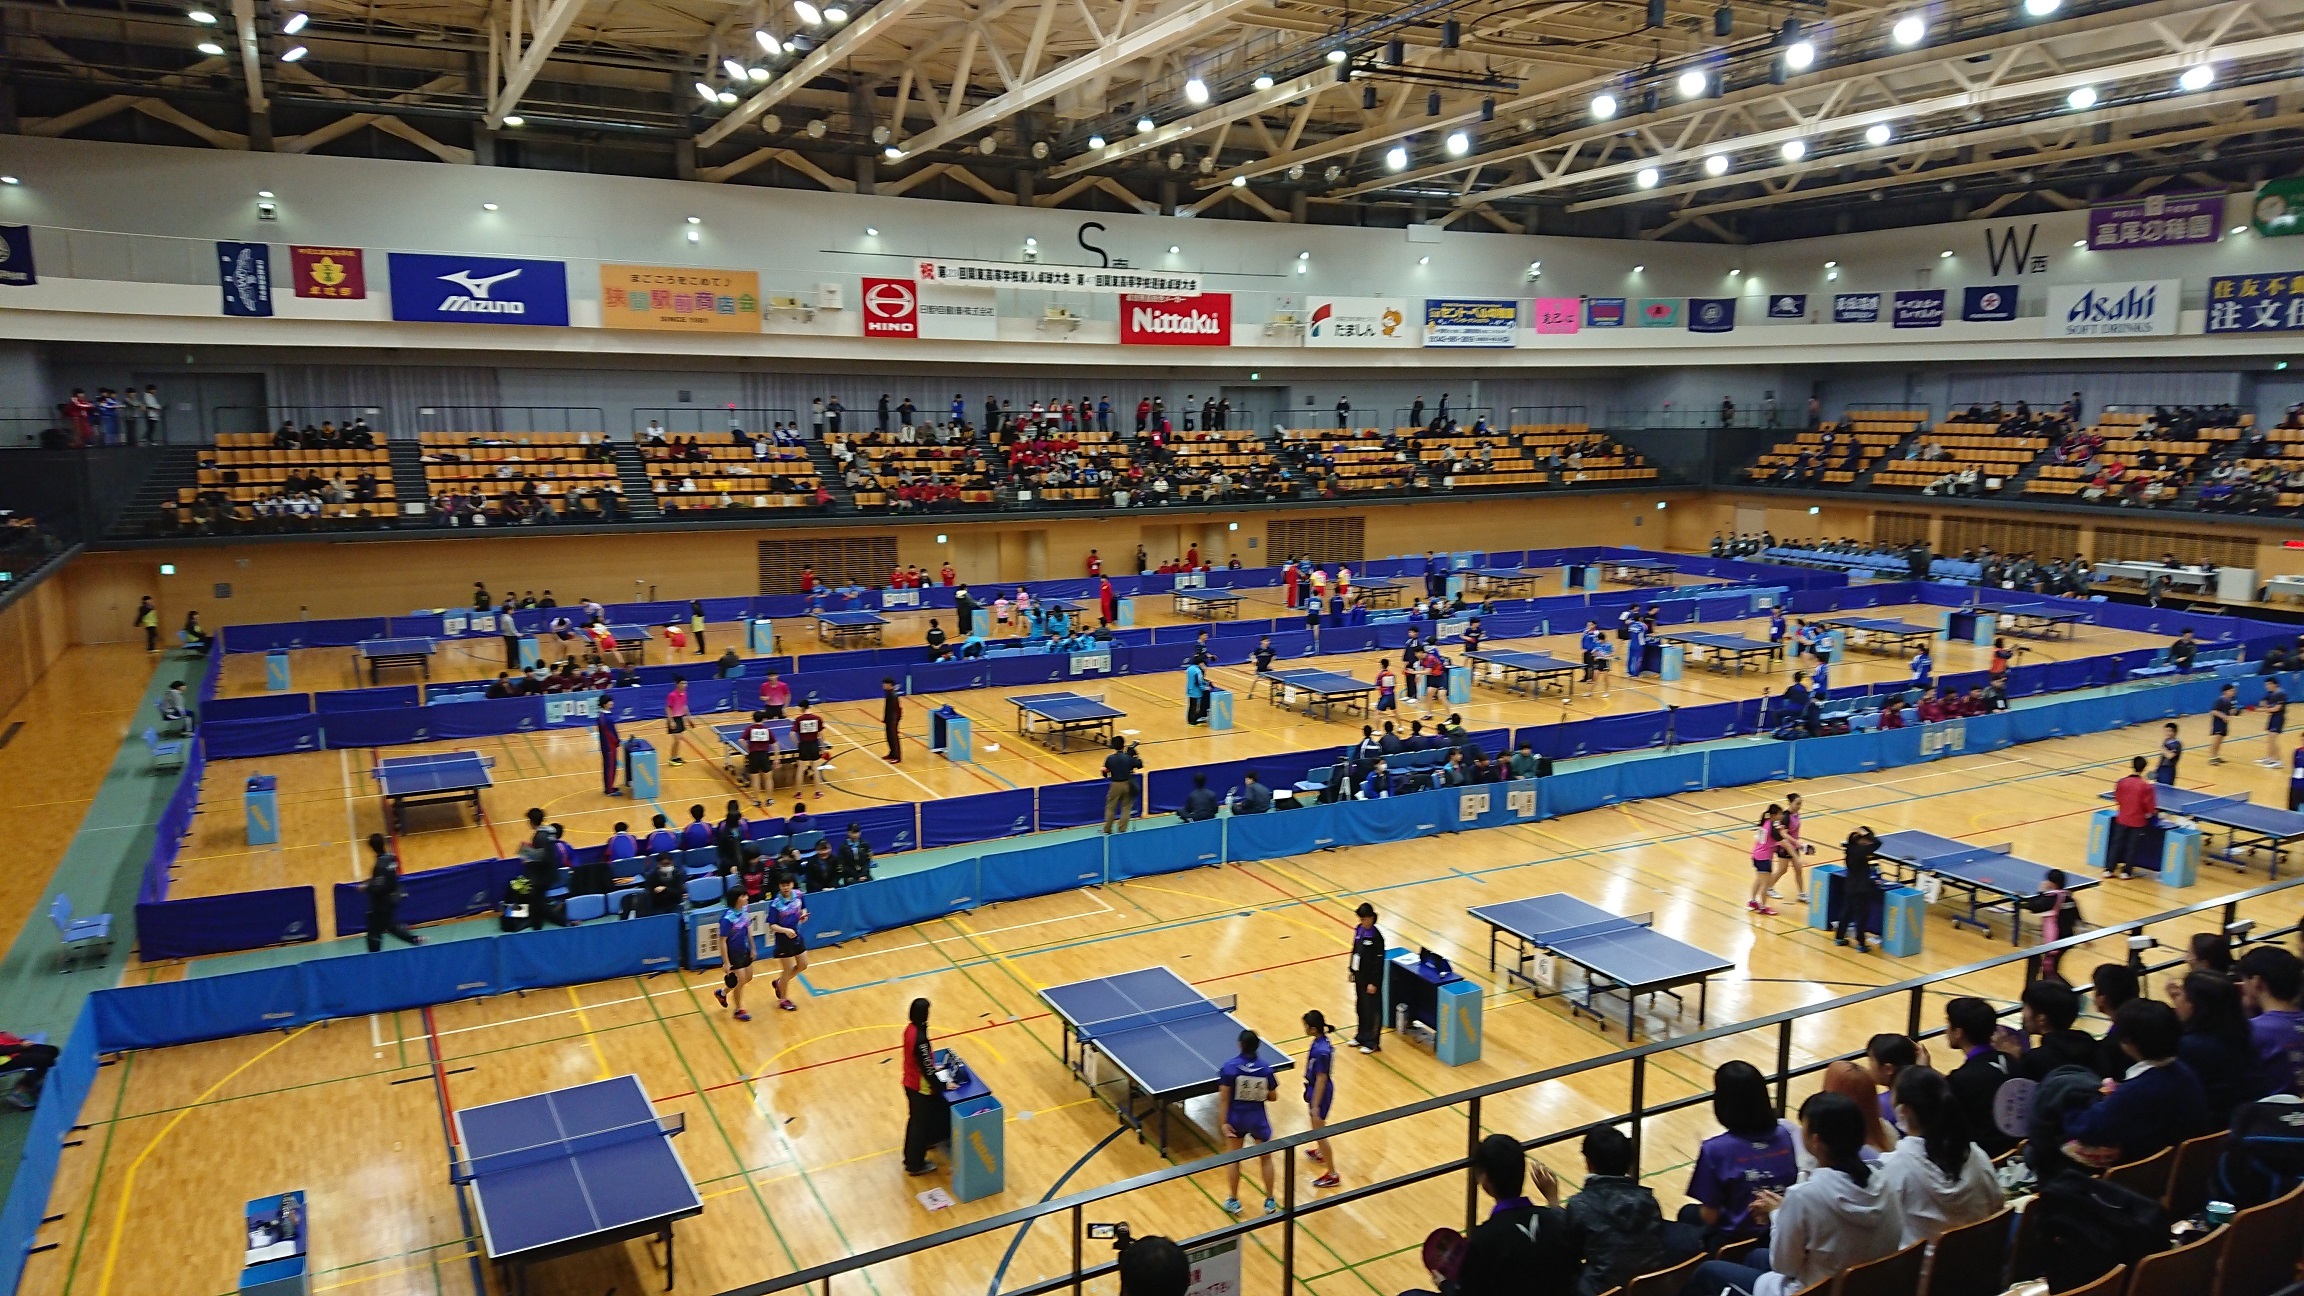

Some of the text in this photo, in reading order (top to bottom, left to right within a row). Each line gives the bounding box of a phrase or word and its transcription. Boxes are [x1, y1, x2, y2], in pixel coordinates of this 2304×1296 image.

[2095, 214, 2214, 245] 高尾幼稚園
[1985, 223, 2038, 276] W
[919, 262, 936, 280] 祝
[2030, 255, 2049, 274] 西
[2067, 285, 2158, 322] Asahi
[868, 322, 914, 332] HINO
[1132, 306, 1221, 335] Nittaku
[1334, 323, 1377, 337] たましん
[2066, 322, 2153, 335] SOFT DRINKS
